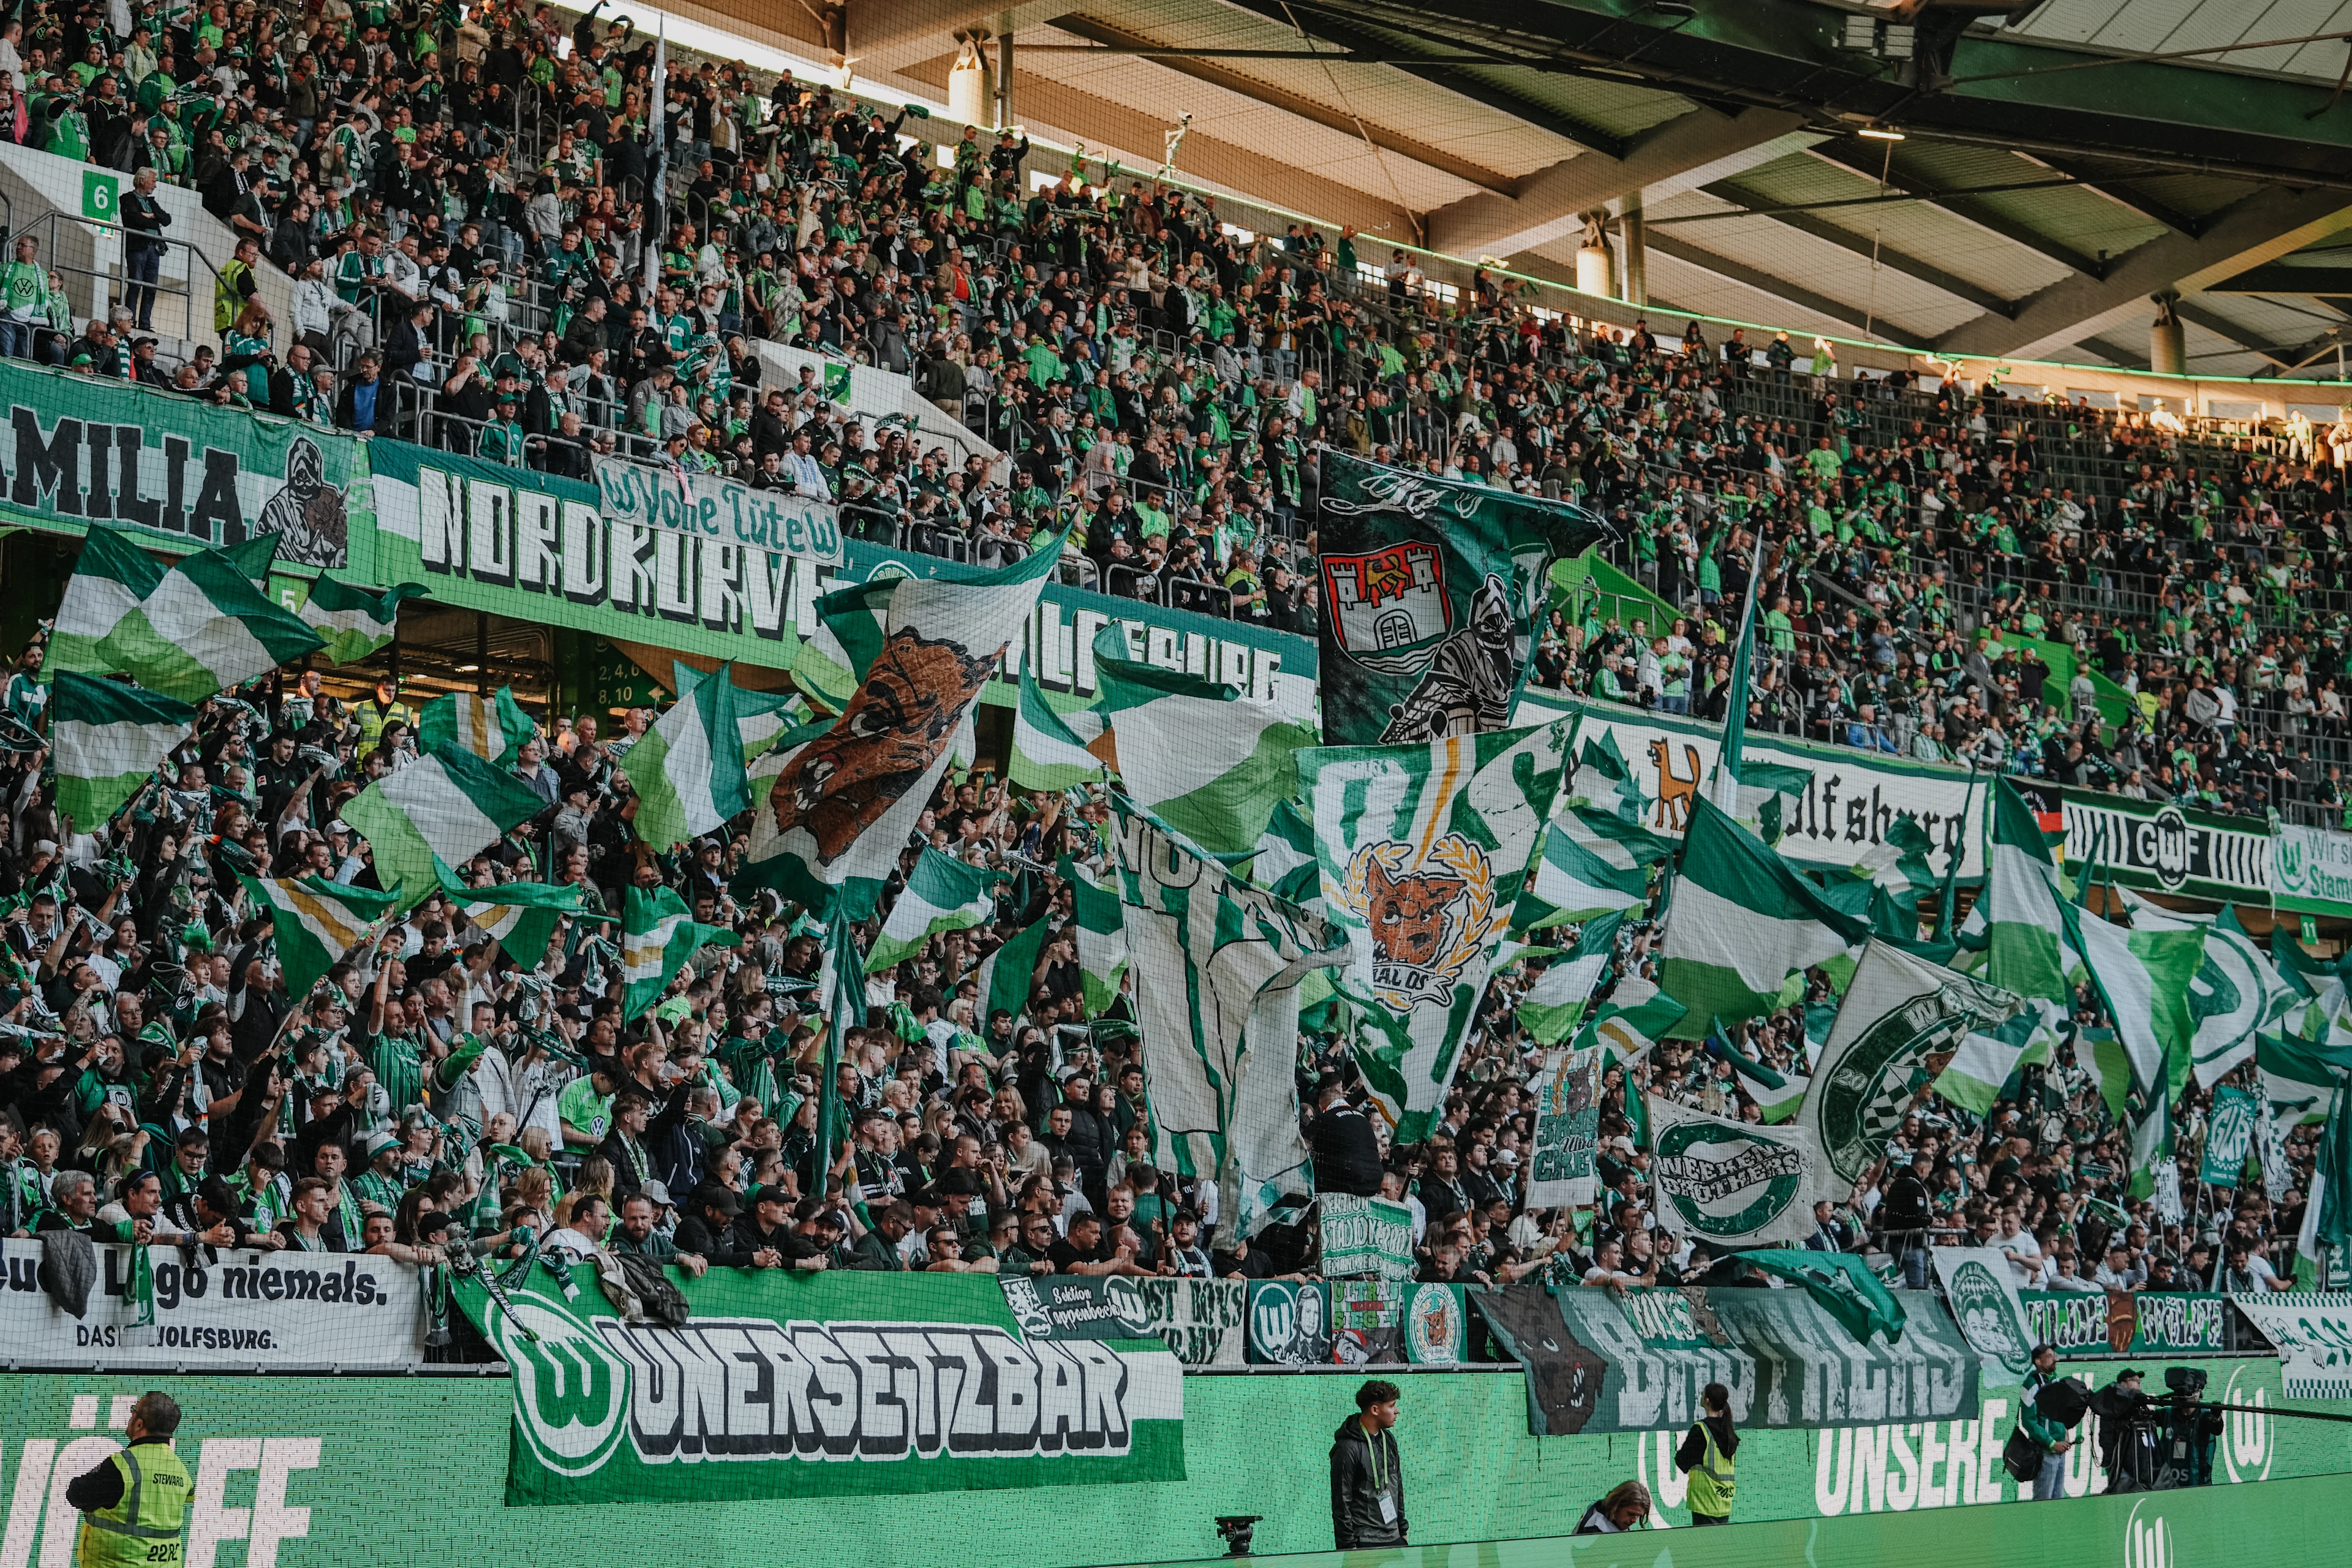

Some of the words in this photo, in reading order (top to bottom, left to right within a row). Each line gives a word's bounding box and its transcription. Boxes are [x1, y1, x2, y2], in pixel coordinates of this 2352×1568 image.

[94, 185, 108, 209] 6
[721, 484, 804, 552] Tüte
[616, 687, 632, 702] 10
[2302, 922, 2316, 939] 11
[1655, 1144, 1797, 1182] WEEKEND
[1659, 1153, 1803, 1204] BROTHERS
[104, 1249, 209, 1310] Lgo
[222, 1254, 388, 1306] niemals.
[1052, 1285, 1092, 1305] Sektion
[1333, 1281, 1400, 1302] ULTRAS
[1039, 1297, 1120, 1330] Tappenbeck
[590, 1317, 1130, 1463] UNERSETZBAR
[1815, 1398, 2008, 1517] UNSERE
[153, 1473, 184, 1487] STEWARD
